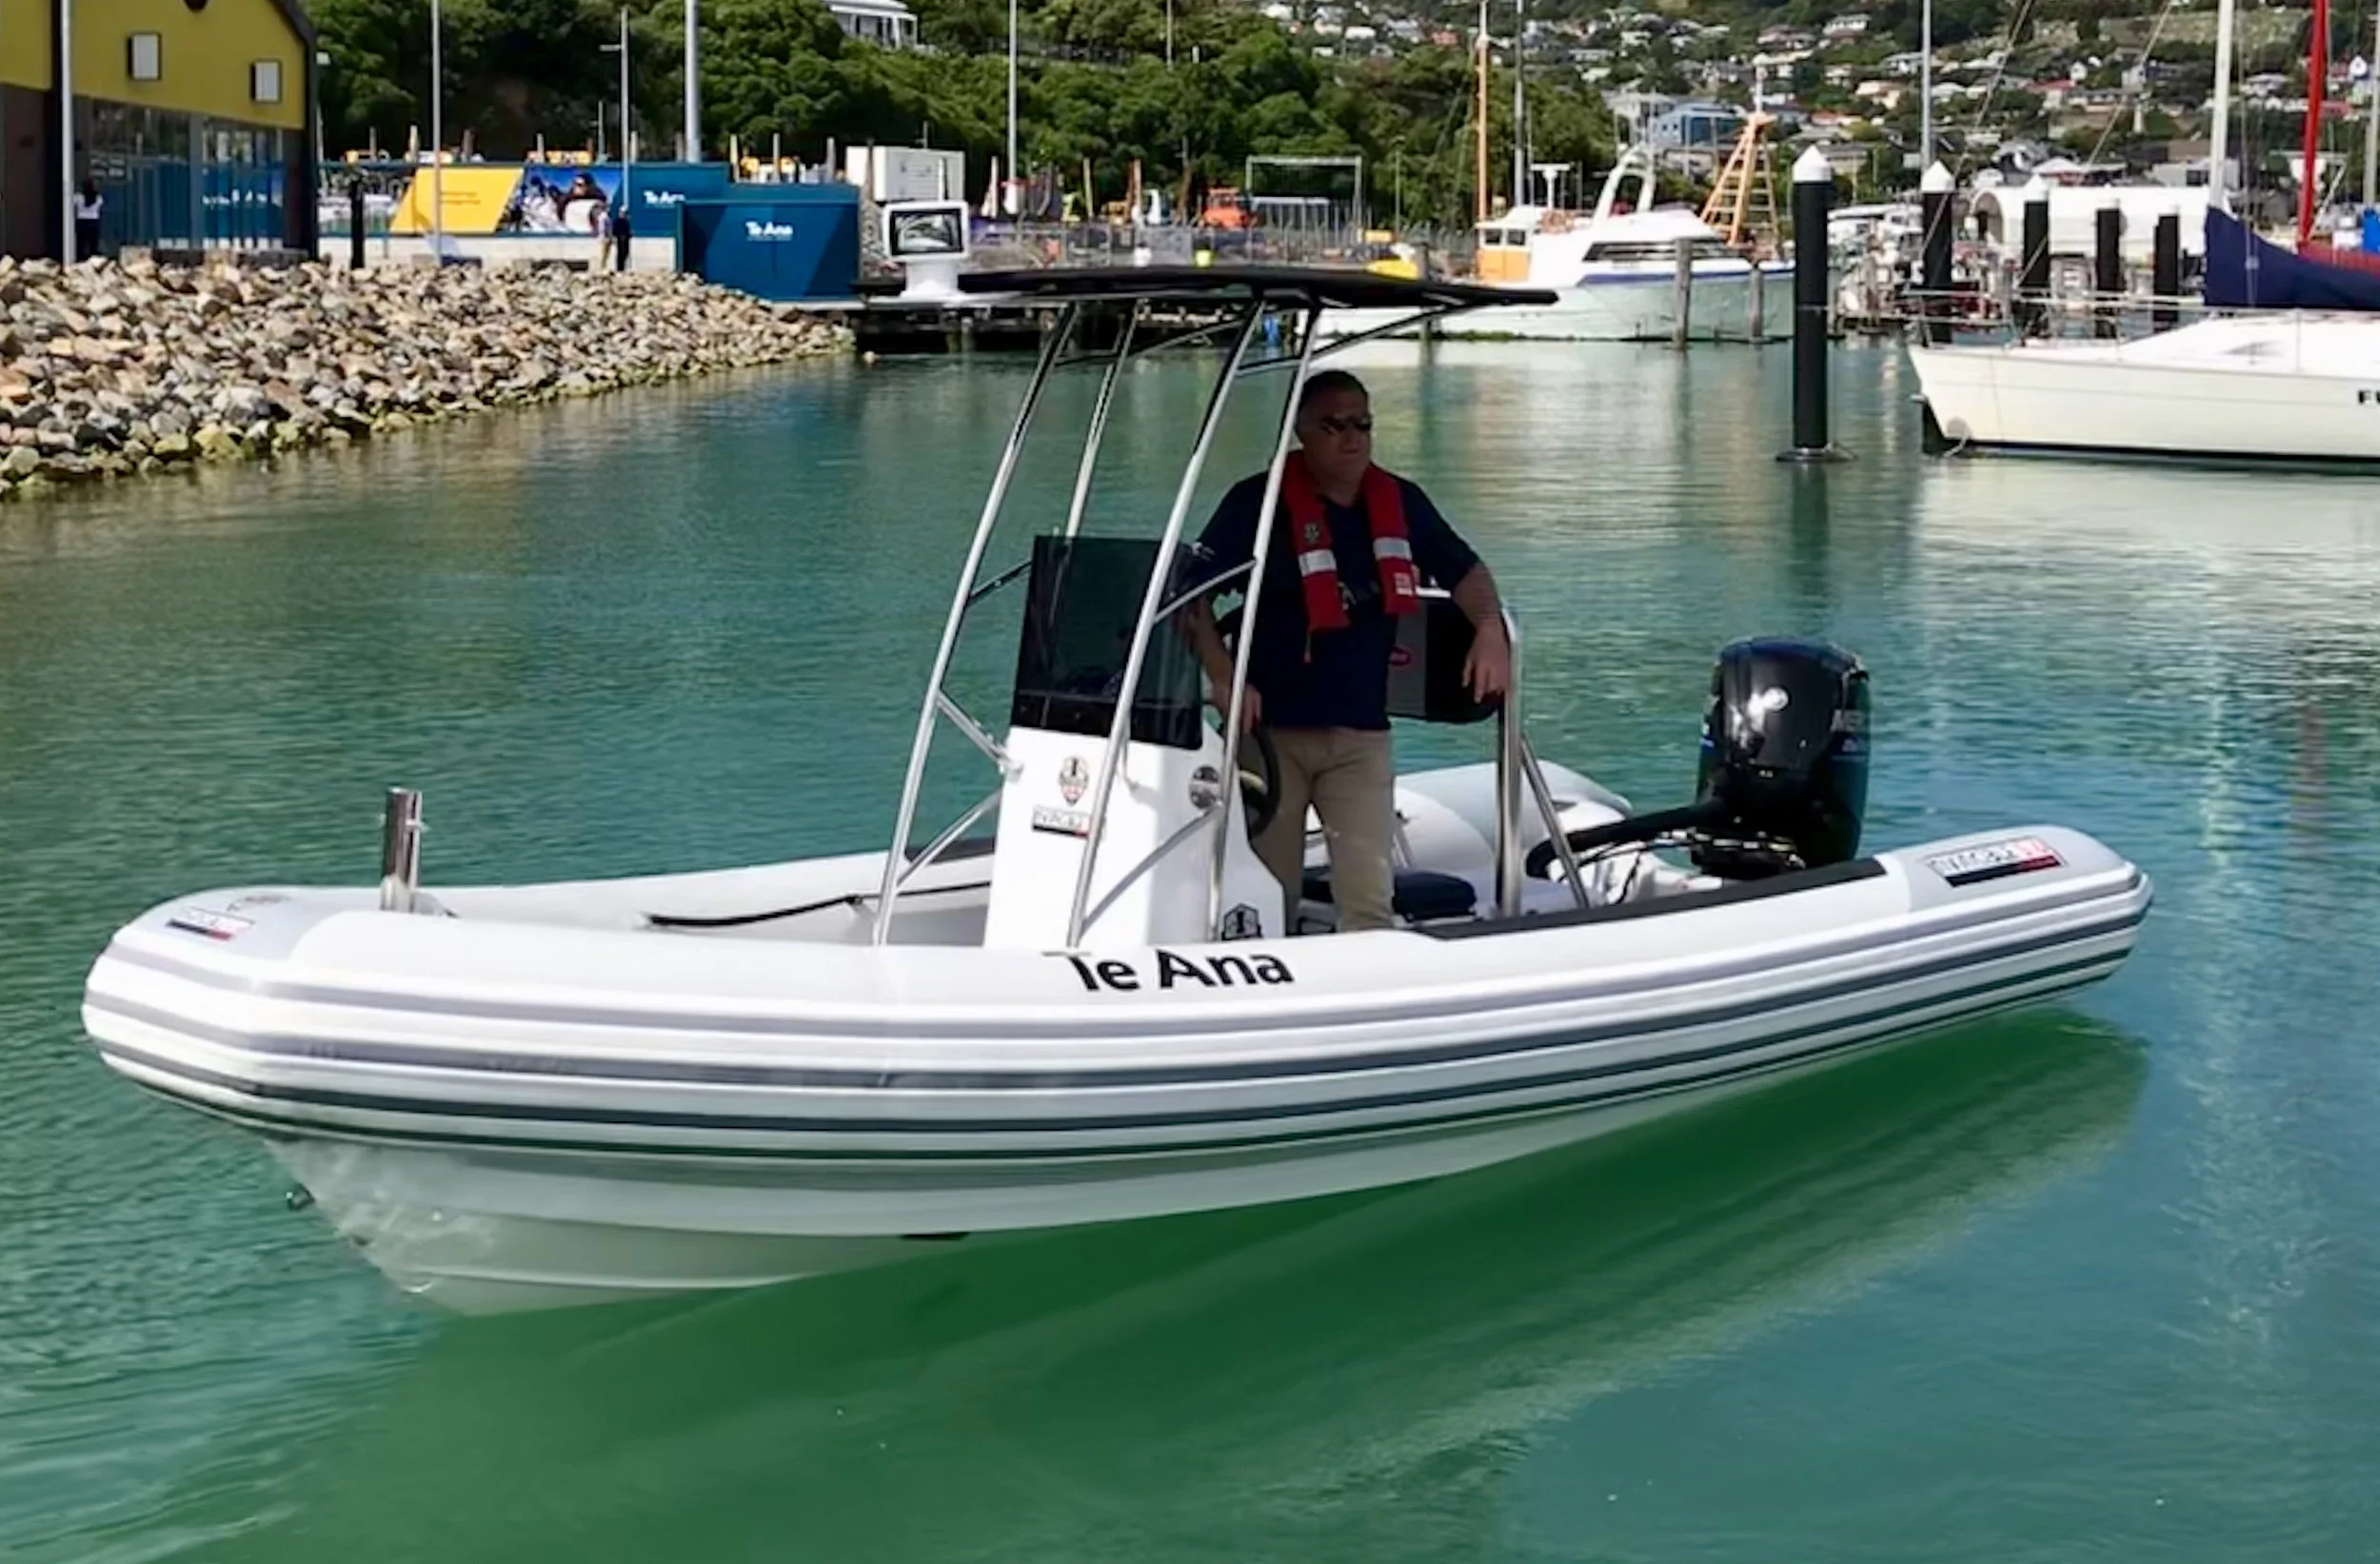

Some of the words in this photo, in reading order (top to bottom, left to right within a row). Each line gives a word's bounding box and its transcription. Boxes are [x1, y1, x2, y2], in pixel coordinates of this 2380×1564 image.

[644, 190, 658, 204] Te
[745, 222, 762, 235] Te
[763, 222, 793, 235] Ana
[1041, 951, 1141, 992] Te
[1155, 949, 1295, 989] Ana
